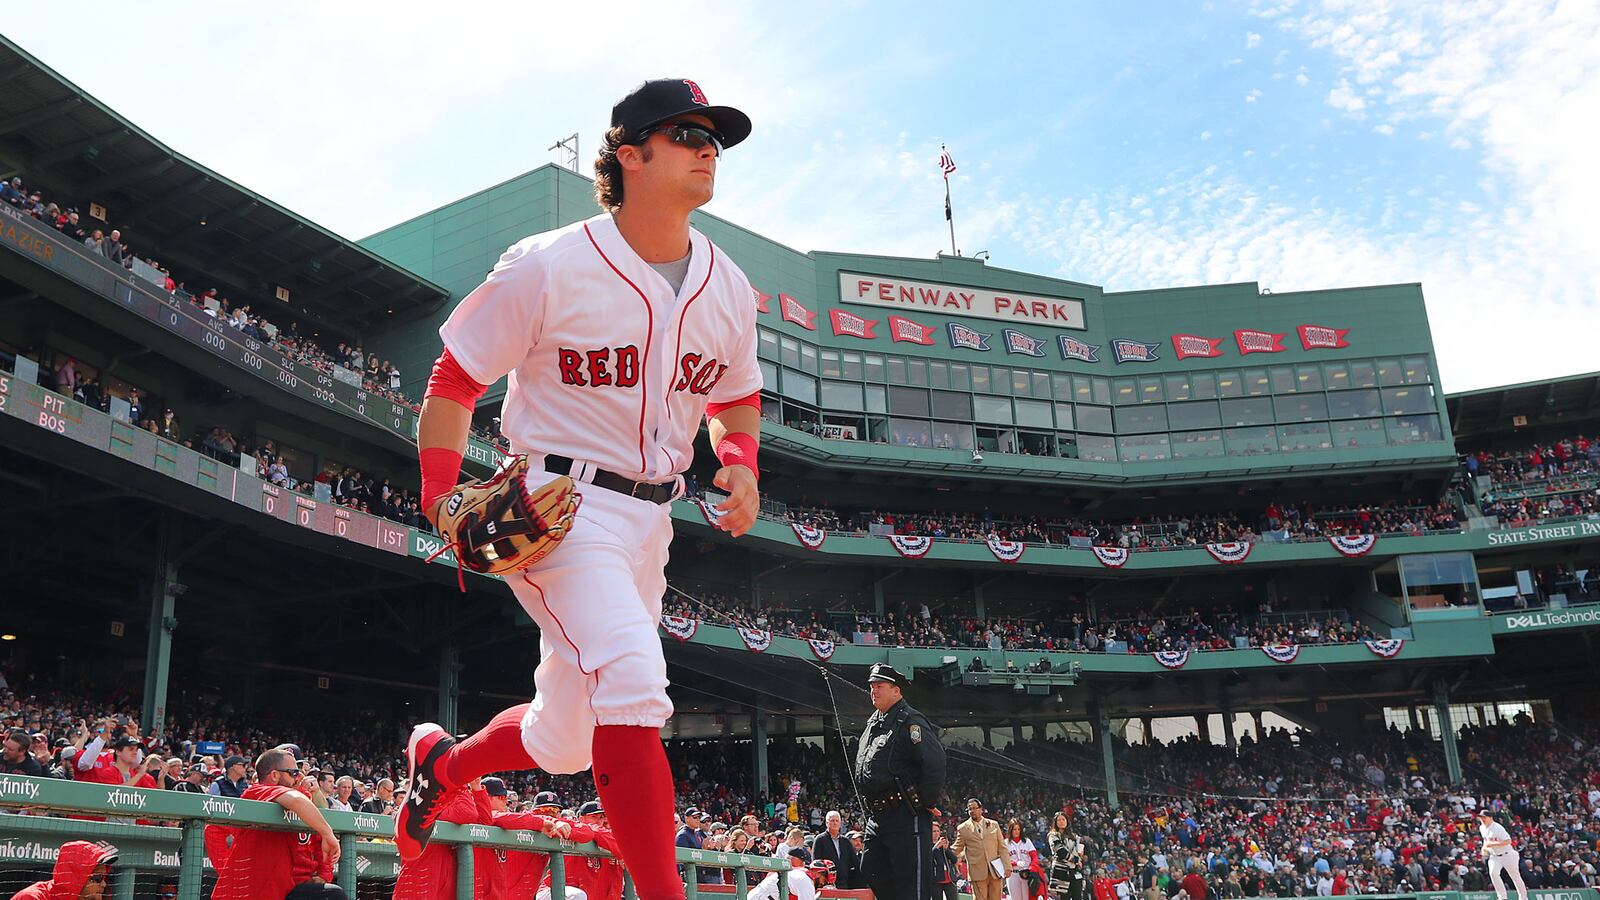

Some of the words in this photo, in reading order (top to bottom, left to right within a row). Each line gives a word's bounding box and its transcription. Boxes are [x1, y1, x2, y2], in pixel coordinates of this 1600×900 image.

[169, 296, 180, 309] PA
[858, 280, 975, 309] FENWAY
[994, 296, 1069, 321] PARK
[170, 313, 177, 325] 0
[208, 319, 223, 333] AVG
[202, 332, 225, 350] .000
[245, 338, 260, 351] OBP
[240, 352, 262, 369] .000
[281, 357, 294, 371] SLG
[558, 345, 640, 387] RED
[276, 371, 297, 388] .000
[318, 374, 333, 387] OPS
[312, 388, 335, 404] .000
[357, 391, 367, 402] HR
[43, 395, 65, 414] PIT
[358, 405, 364, 415] 0
[391, 405, 404, 416] RBI
[39, 412, 65, 433] BOS
[394, 418, 400, 428] 0
[465, 443, 488, 462] REET
[263, 483, 279, 496] BALLS
[266, 497, 274, 513] 0
[296, 496, 317, 509] STRIKES
[301, 510, 309, 525] 0
[335, 509, 350, 518] OUTS
[338, 521, 346, 536] 0
[1488, 532, 1527, 545] STATE
[1528, 525, 1576, 541] STREET
[1506, 614, 1546, 629] DELL
[107, 789, 146, 809] xfinity
[202, 798, 235, 816] xfinity
[354, 815, 379, 830] xfinity
[470, 826, 489, 839] xfinity
[0, 841, 16, 857] nk
[16, 842, 32, 858] of
[154, 850, 180, 866] Bank
